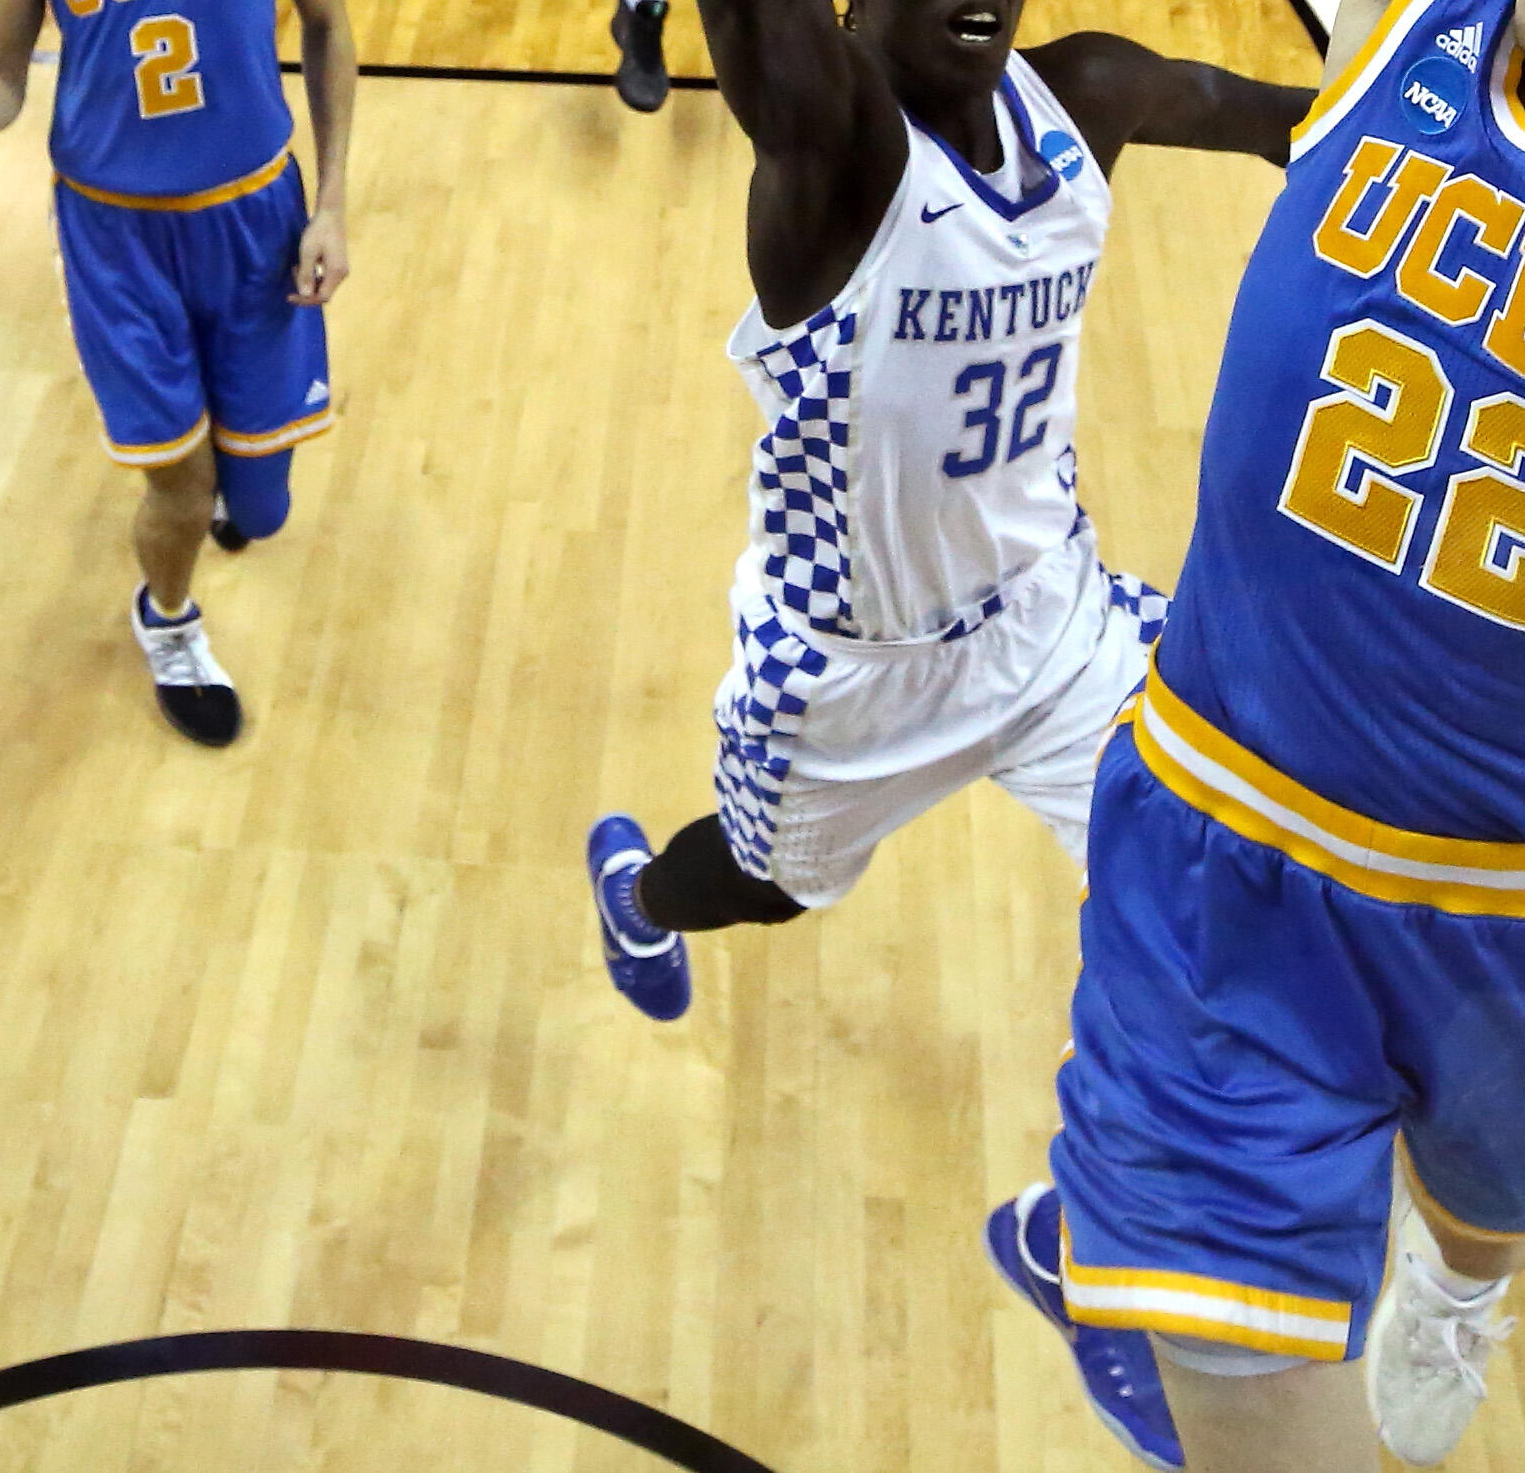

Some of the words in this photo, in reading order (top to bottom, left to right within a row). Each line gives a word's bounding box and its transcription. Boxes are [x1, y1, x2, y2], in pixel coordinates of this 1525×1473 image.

[130, 13, 205, 121] 2
[1435, 33, 1478, 74] adida
[1403, 80, 1458, 129] NCAA
[894, 260, 1096, 343] KENTUCK
[941, 342, 1062, 479] 32
